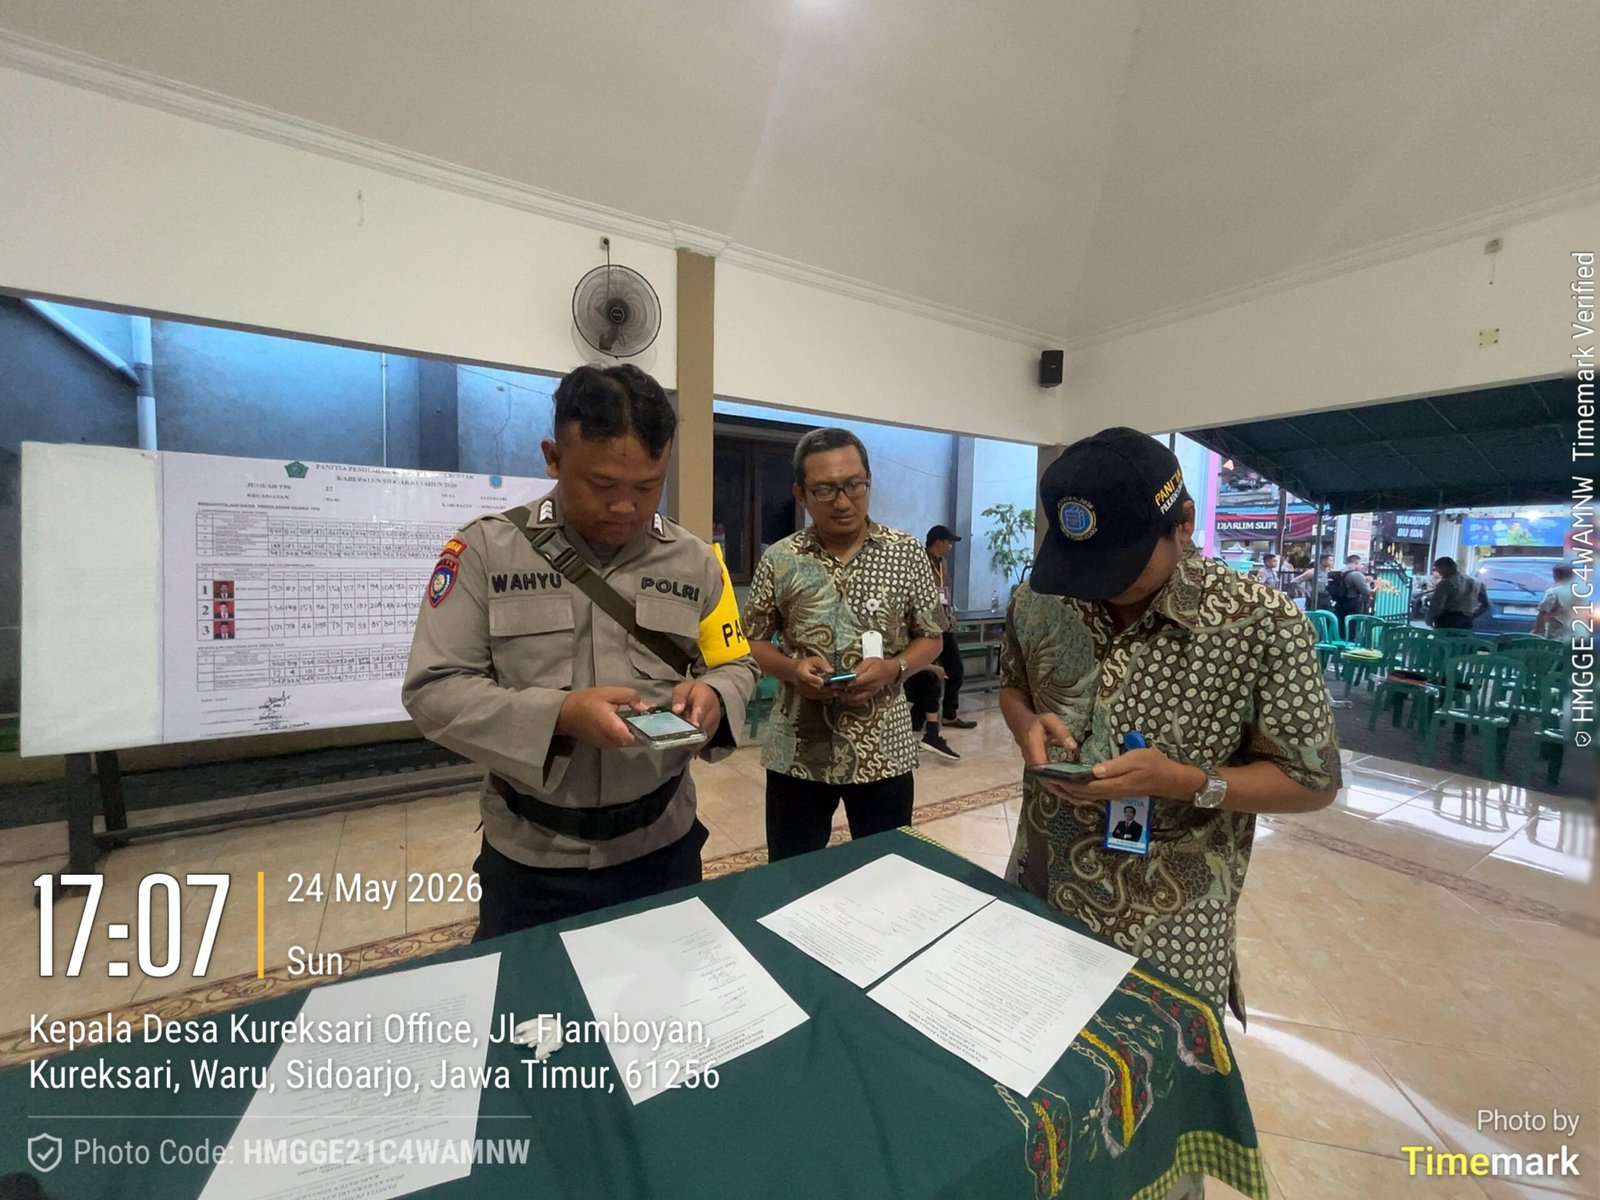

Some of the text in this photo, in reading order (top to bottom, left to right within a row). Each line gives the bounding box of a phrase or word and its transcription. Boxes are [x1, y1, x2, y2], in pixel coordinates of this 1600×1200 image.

[1396, 515, 1430, 526] WARUNG
[1217, 522, 1254, 530] DJARUM
[492, 573, 562, 593] WAHYU
[641, 576, 700, 600] POLRI
[202, 605, 209, 615] 2
[202, 626, 209, 635] 3
